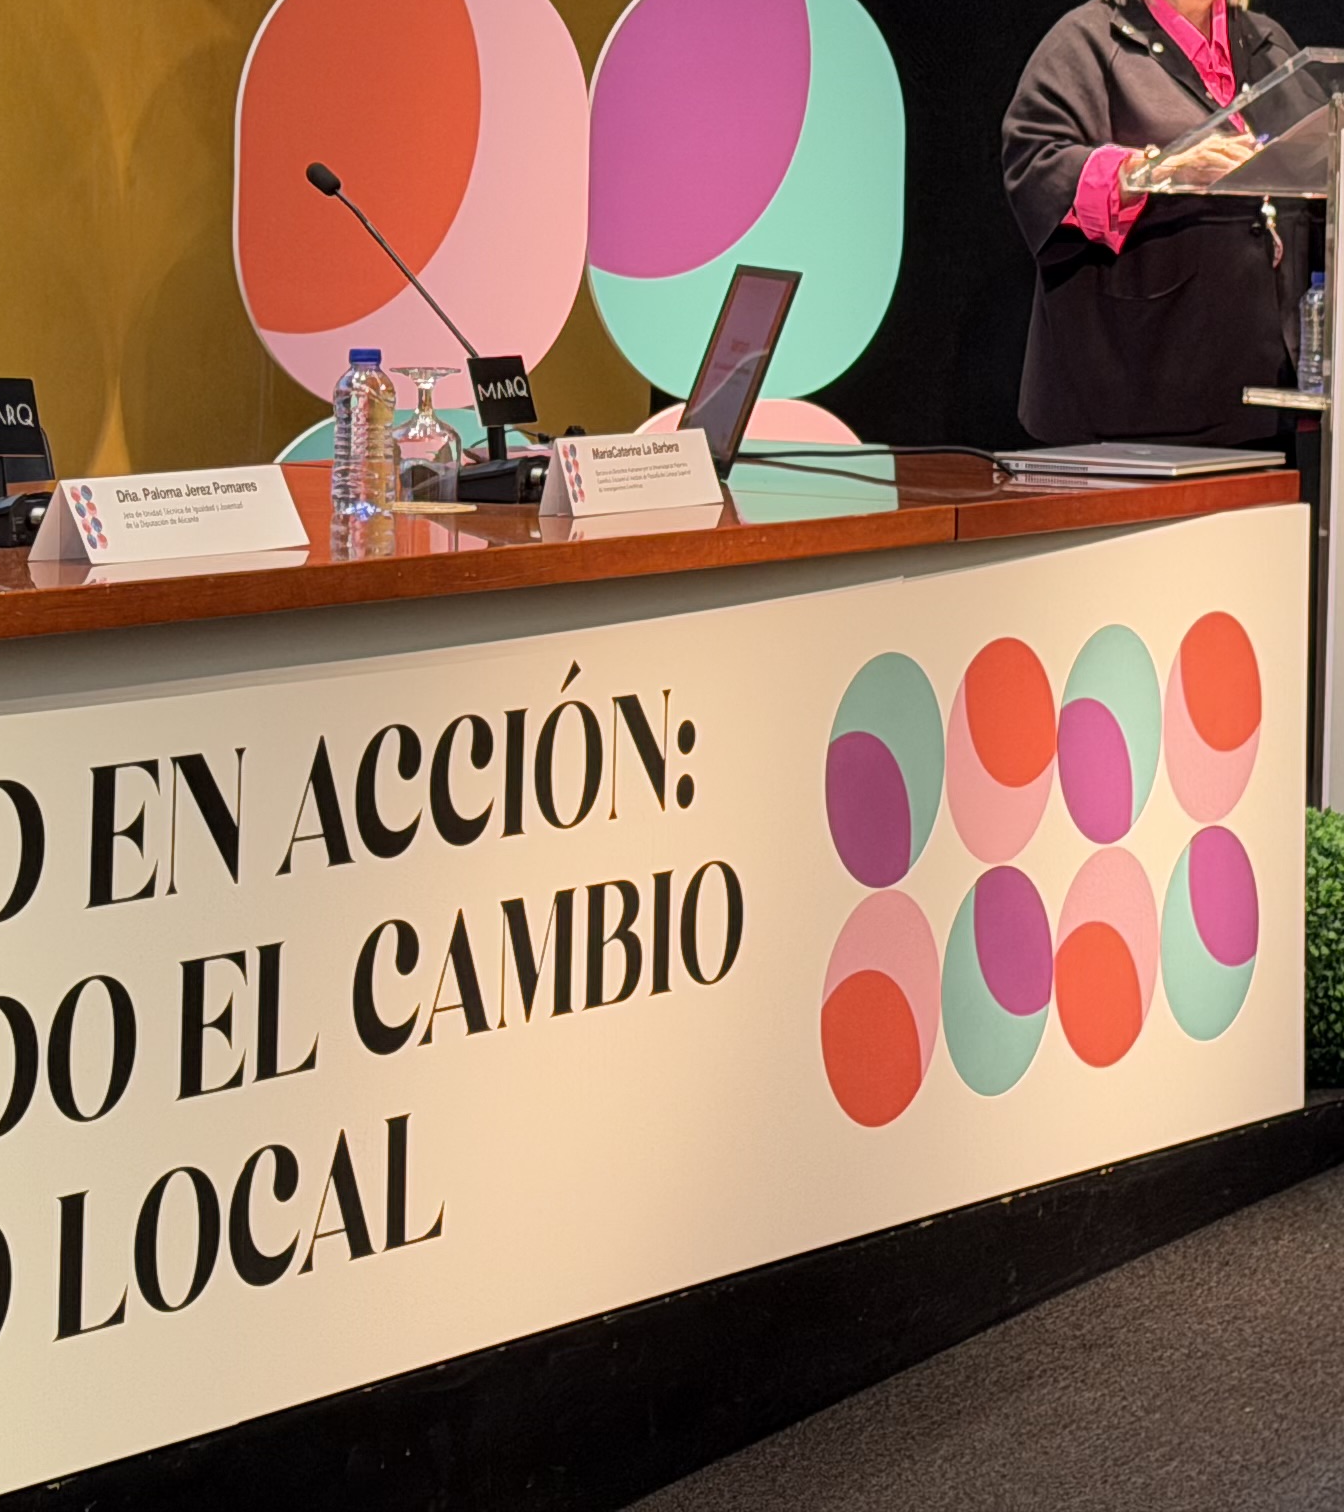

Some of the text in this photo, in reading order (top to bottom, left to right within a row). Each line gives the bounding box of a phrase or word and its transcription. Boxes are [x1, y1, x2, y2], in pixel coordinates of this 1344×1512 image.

[116, 481, 257, 503] Dña. Paloma Jerez Pomares
[477, 375, 529, 402] MARQ
[85, 746, 247, 910] EN
[275, 661, 697, 877] ACCIÓN:
[176, 940, 319, 1102] EL
[351, 859, 745, 1056] CAMBIO
[52, 1112, 446, 1343] LOCAL
